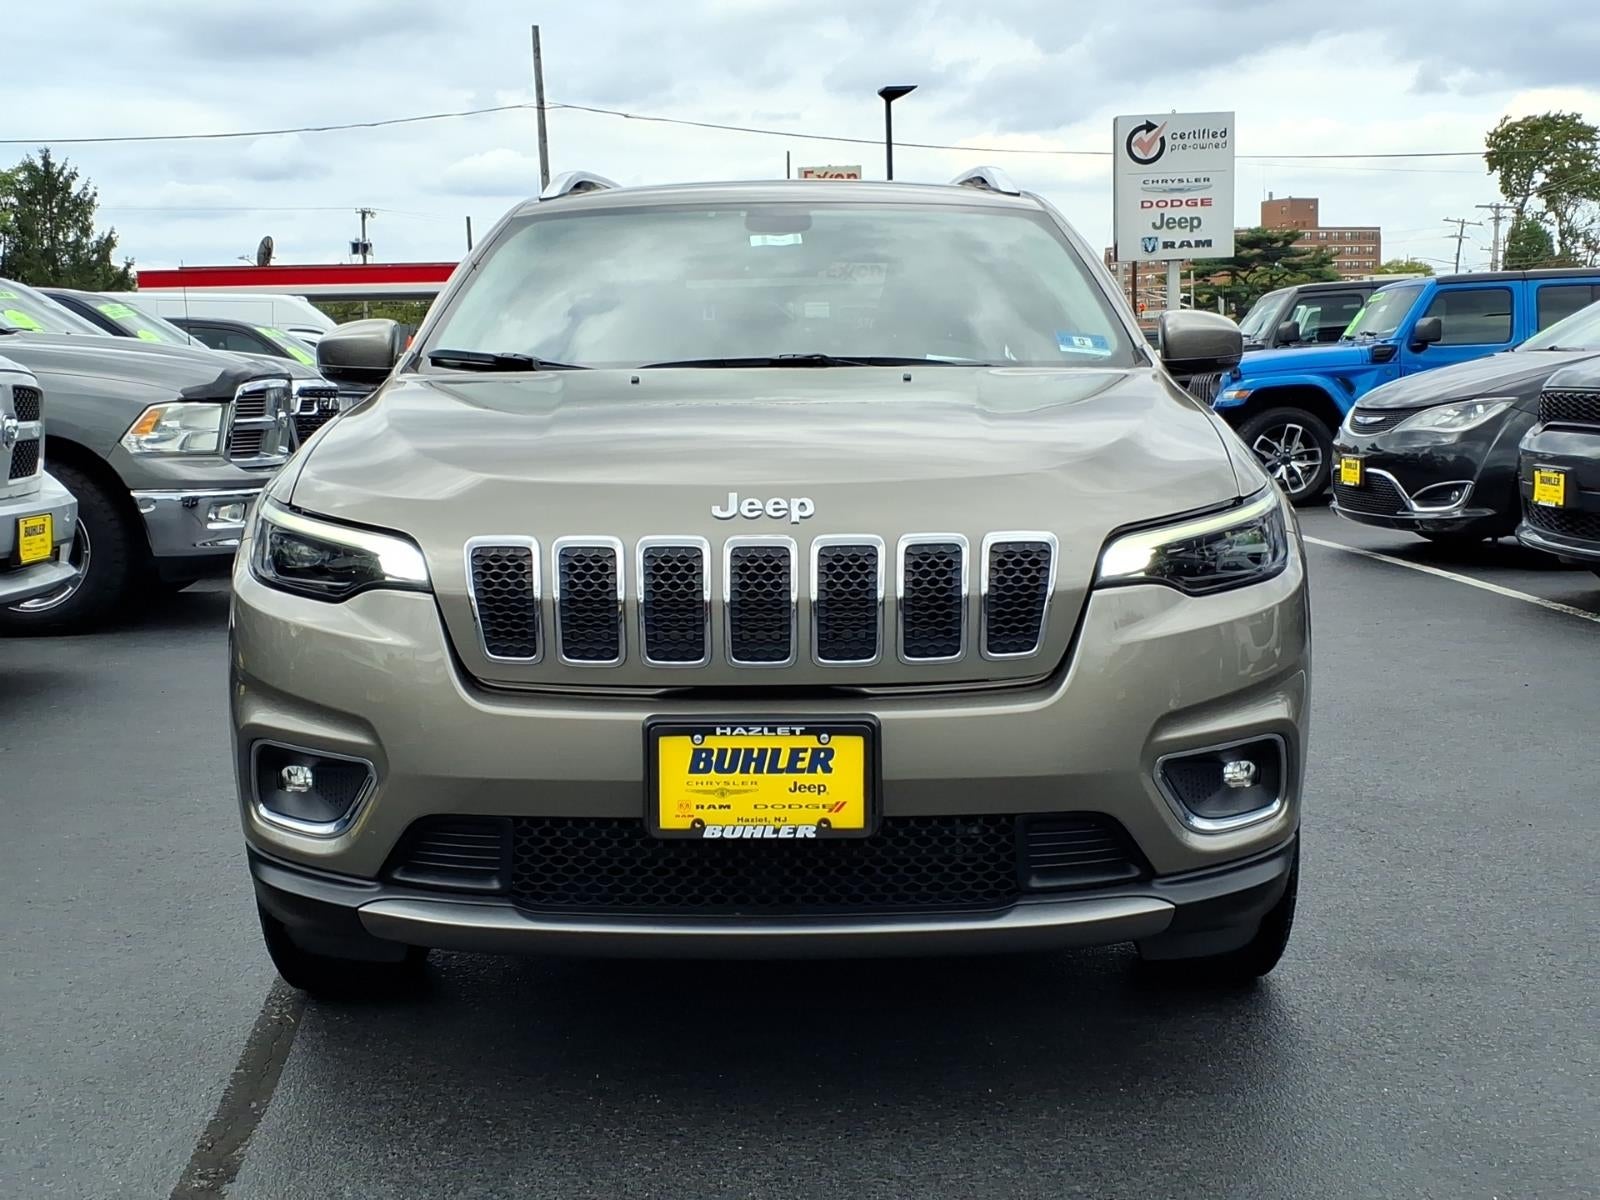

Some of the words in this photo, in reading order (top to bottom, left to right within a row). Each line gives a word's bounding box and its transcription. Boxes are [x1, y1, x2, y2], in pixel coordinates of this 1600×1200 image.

[1170, 128, 1228, 140] certified
[1170, 140, 1228, 153] pre-owned
[1142, 177, 1211, 185] CHRYSLER
[1140, 198, 1213, 209] DODGE
[1151, 213, 1202, 232] Jeep
[1162, 239, 1213, 249] RAM
[711, 491, 815, 525] Jeep
[715, 726, 806, 736] HAZLET
[688, 746, 835, 775] BUHLER
[788, 780, 827, 796] Jeep
[695, 803, 732, 811] RAM
[702, 824, 818, 839] BUHLER
